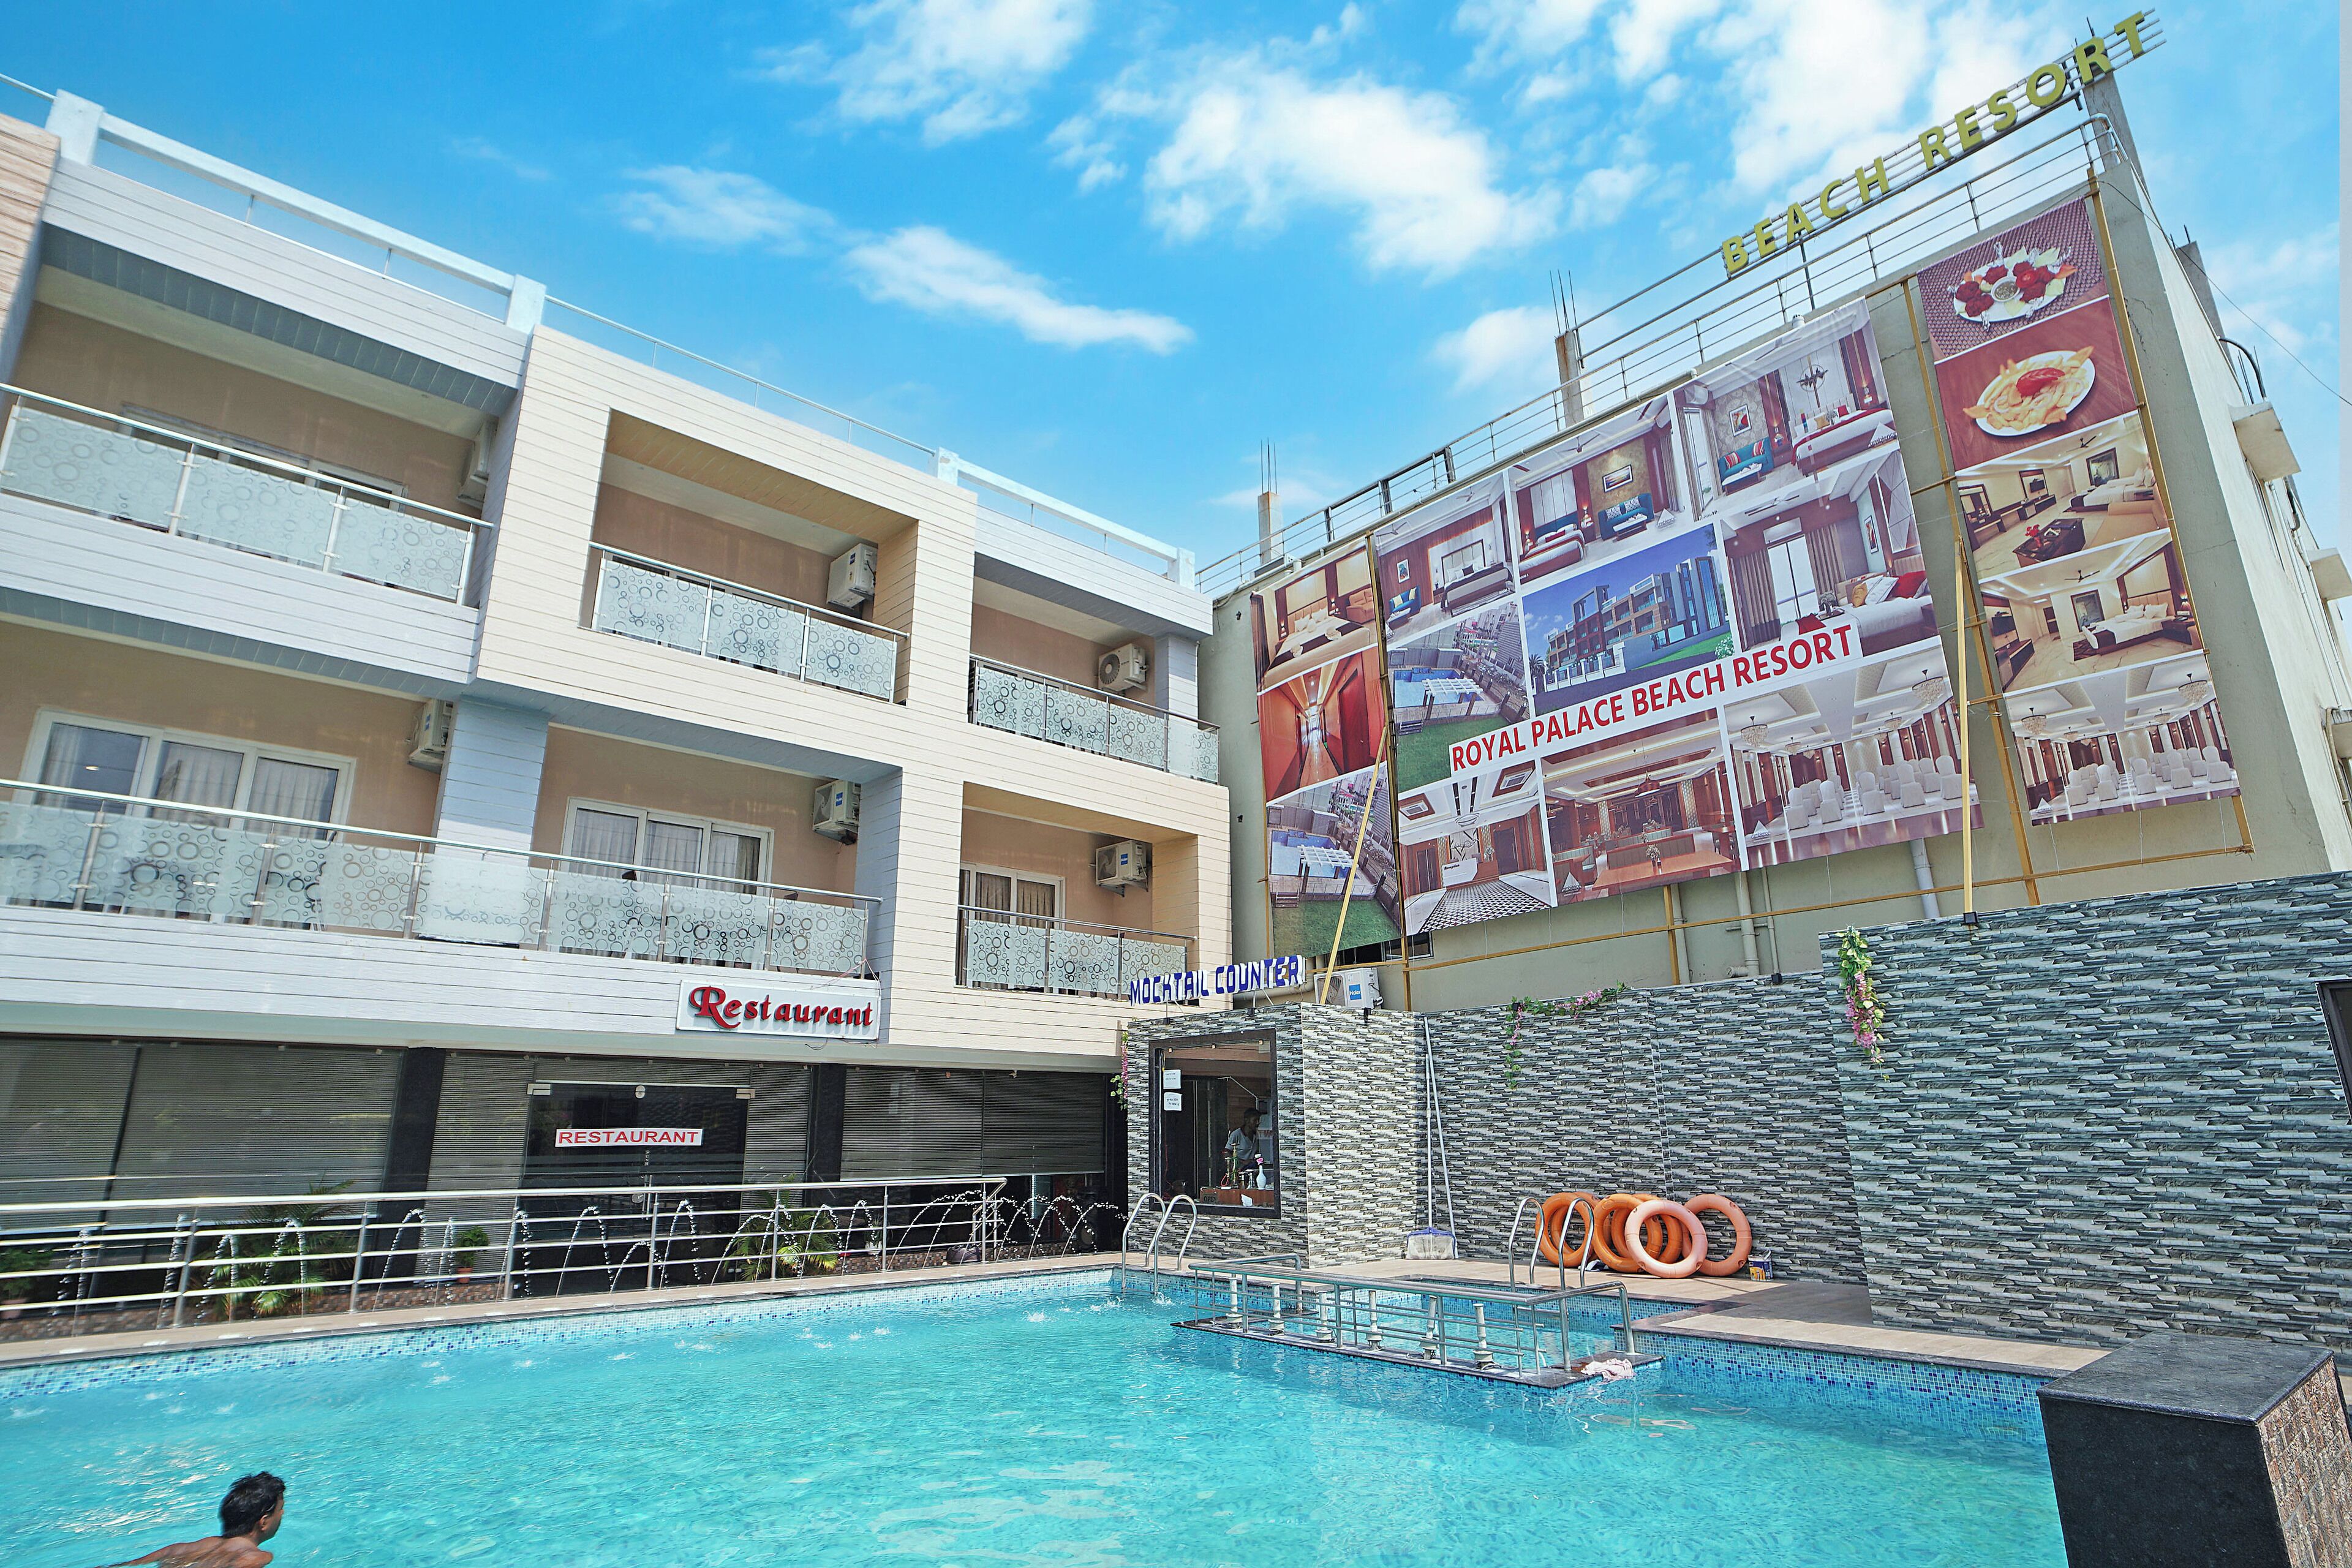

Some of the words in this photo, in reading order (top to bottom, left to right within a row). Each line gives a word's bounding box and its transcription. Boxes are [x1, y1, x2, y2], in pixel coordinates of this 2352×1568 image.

[1722, 157, 1891, 276] BEACH
[1918, 10, 2146, 171] RESORT
[1453, 725, 1526, 772] ROYAL
[1531, 694, 1626, 748] PALACE
[1631, 663, 1725, 717] BEACH
[1733, 624, 1853, 688] RESORT
[1130, 970, 1210, 1006] MOCKTAIL
[1215, 954, 1303, 994] COUNTER
[689, 986, 873, 1029] Restaurant
[557, 1131, 699, 1144] RESTAURANT
